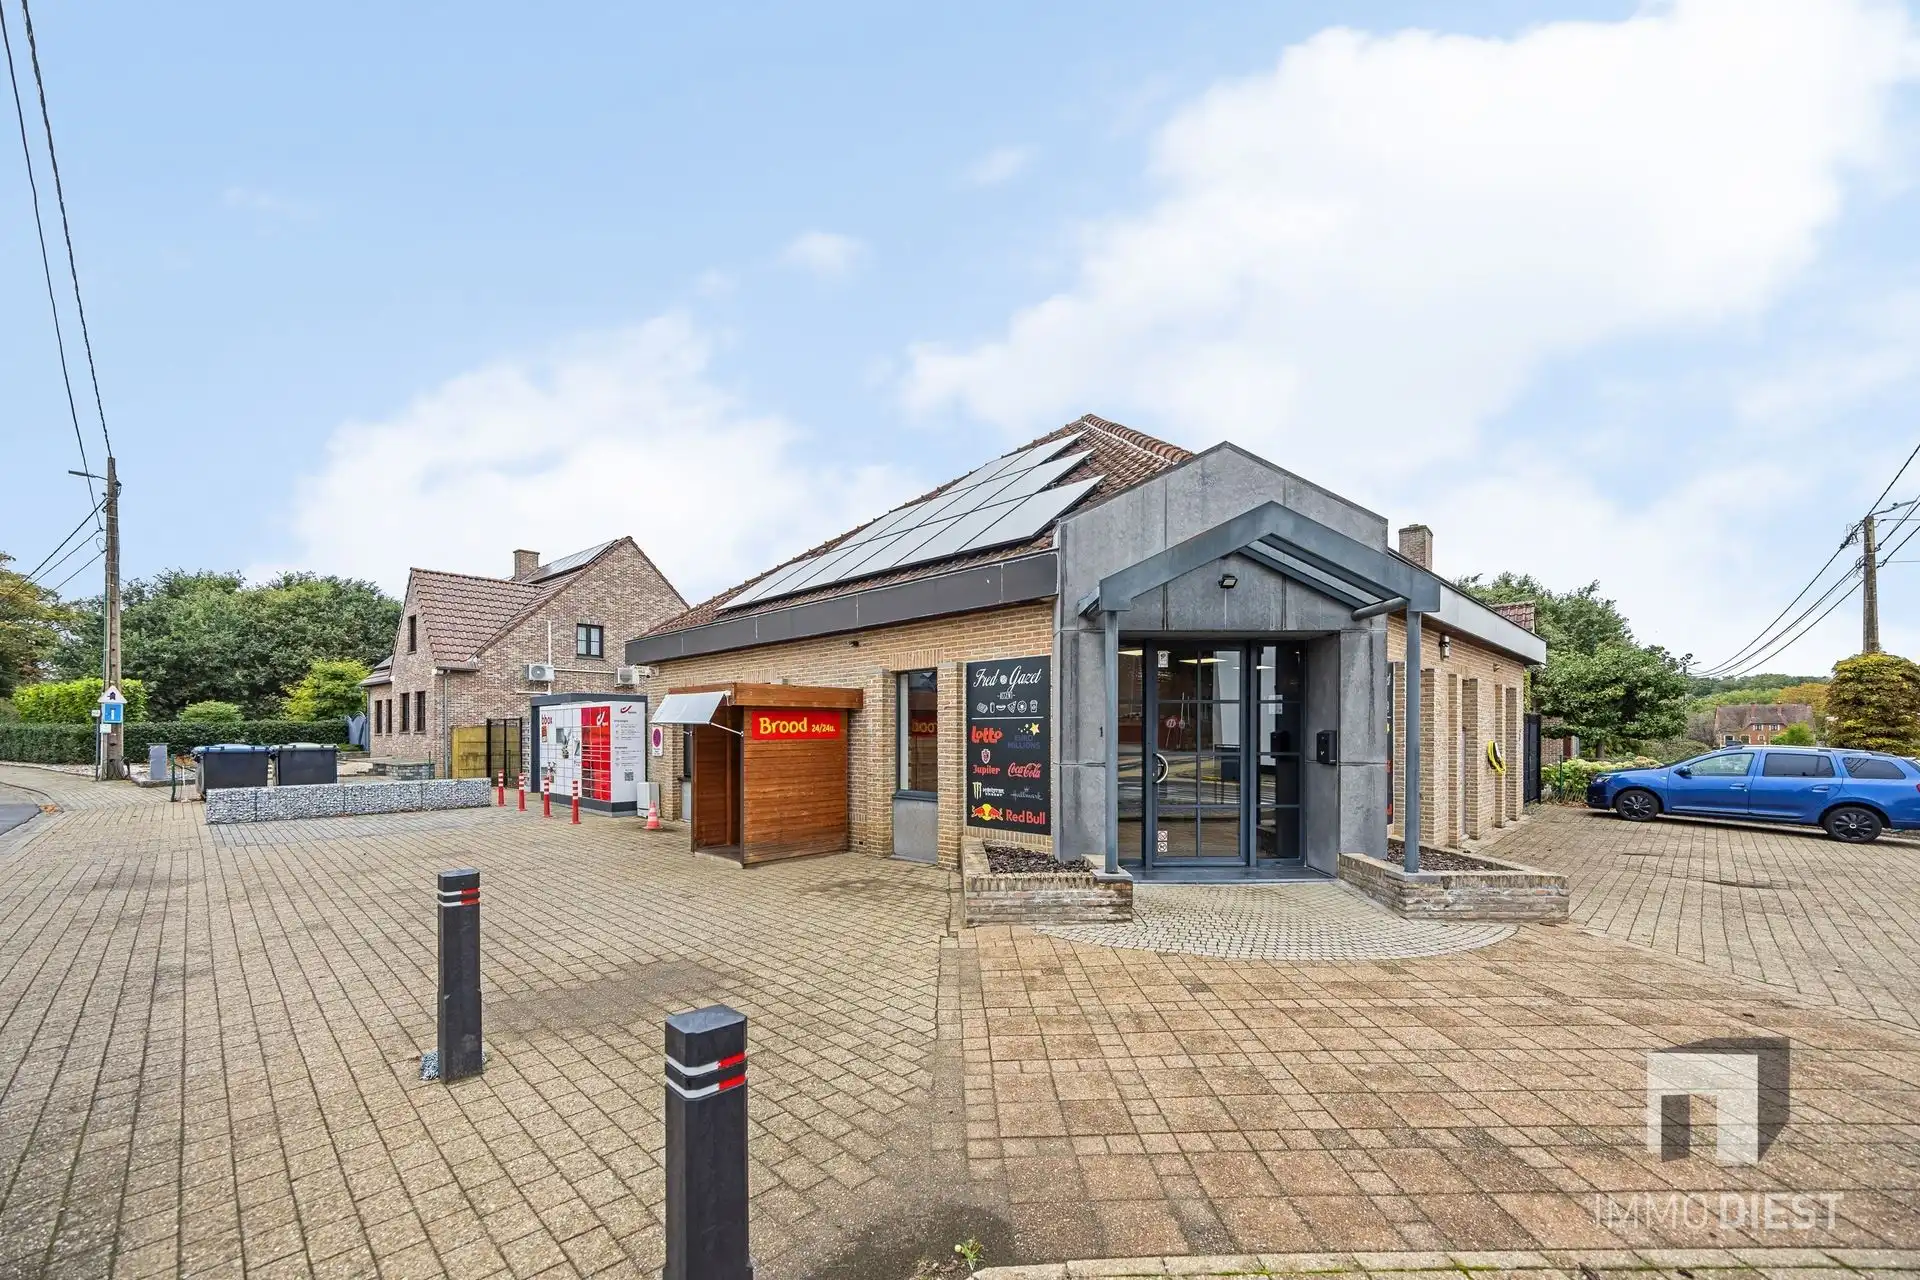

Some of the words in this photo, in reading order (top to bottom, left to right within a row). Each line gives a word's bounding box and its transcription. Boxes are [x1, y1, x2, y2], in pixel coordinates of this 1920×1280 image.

[973, 668, 1000, 687] Fred
[759, 717, 808, 734] Brood
[1005, 808, 1026, 823] Red
[1026, 811, 1046, 825] Bull
